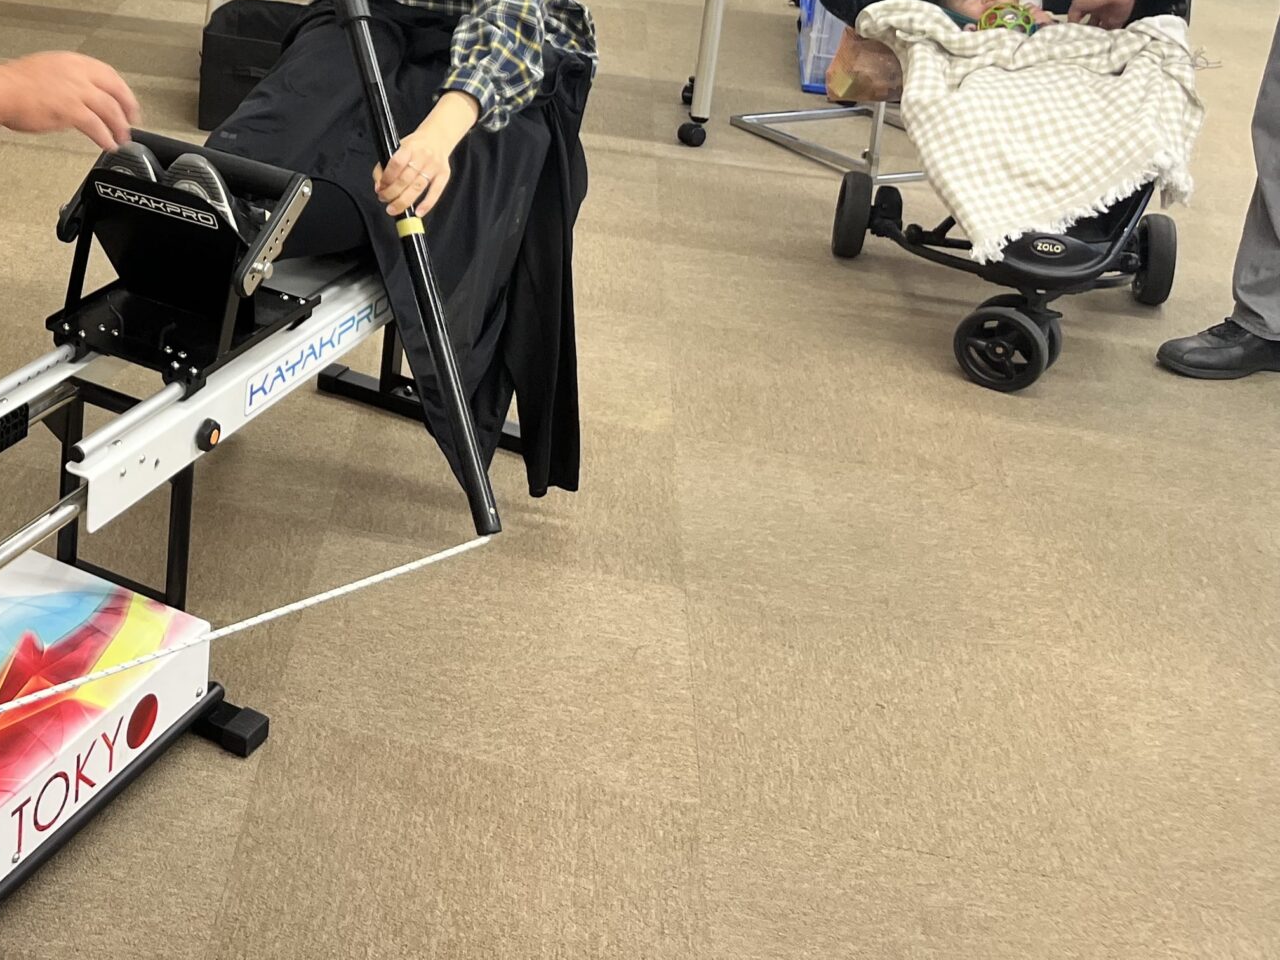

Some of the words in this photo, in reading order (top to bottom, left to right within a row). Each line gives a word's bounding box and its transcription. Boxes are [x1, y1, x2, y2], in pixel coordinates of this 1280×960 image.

[99, 183, 215, 226] KAYAKPRO
[1036, 242, 1062, 253] ZOLO
[248, 293, 391, 407] KAYAKPRO
